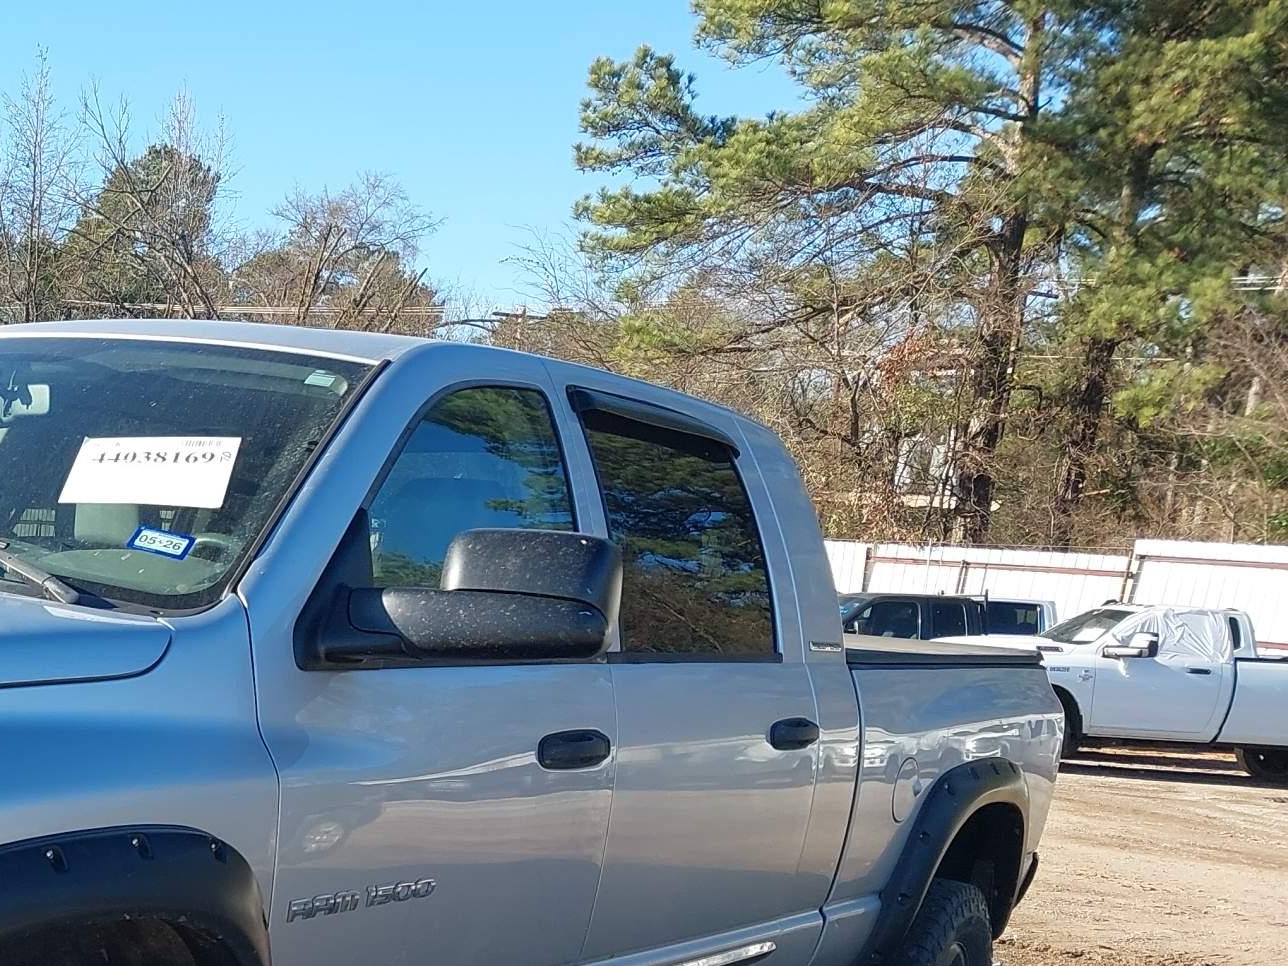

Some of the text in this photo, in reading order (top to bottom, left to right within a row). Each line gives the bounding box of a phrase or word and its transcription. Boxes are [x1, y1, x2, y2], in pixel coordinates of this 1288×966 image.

[92, 451, 215, 464] 44038169
[286, 878, 437, 923] RAM 1500
